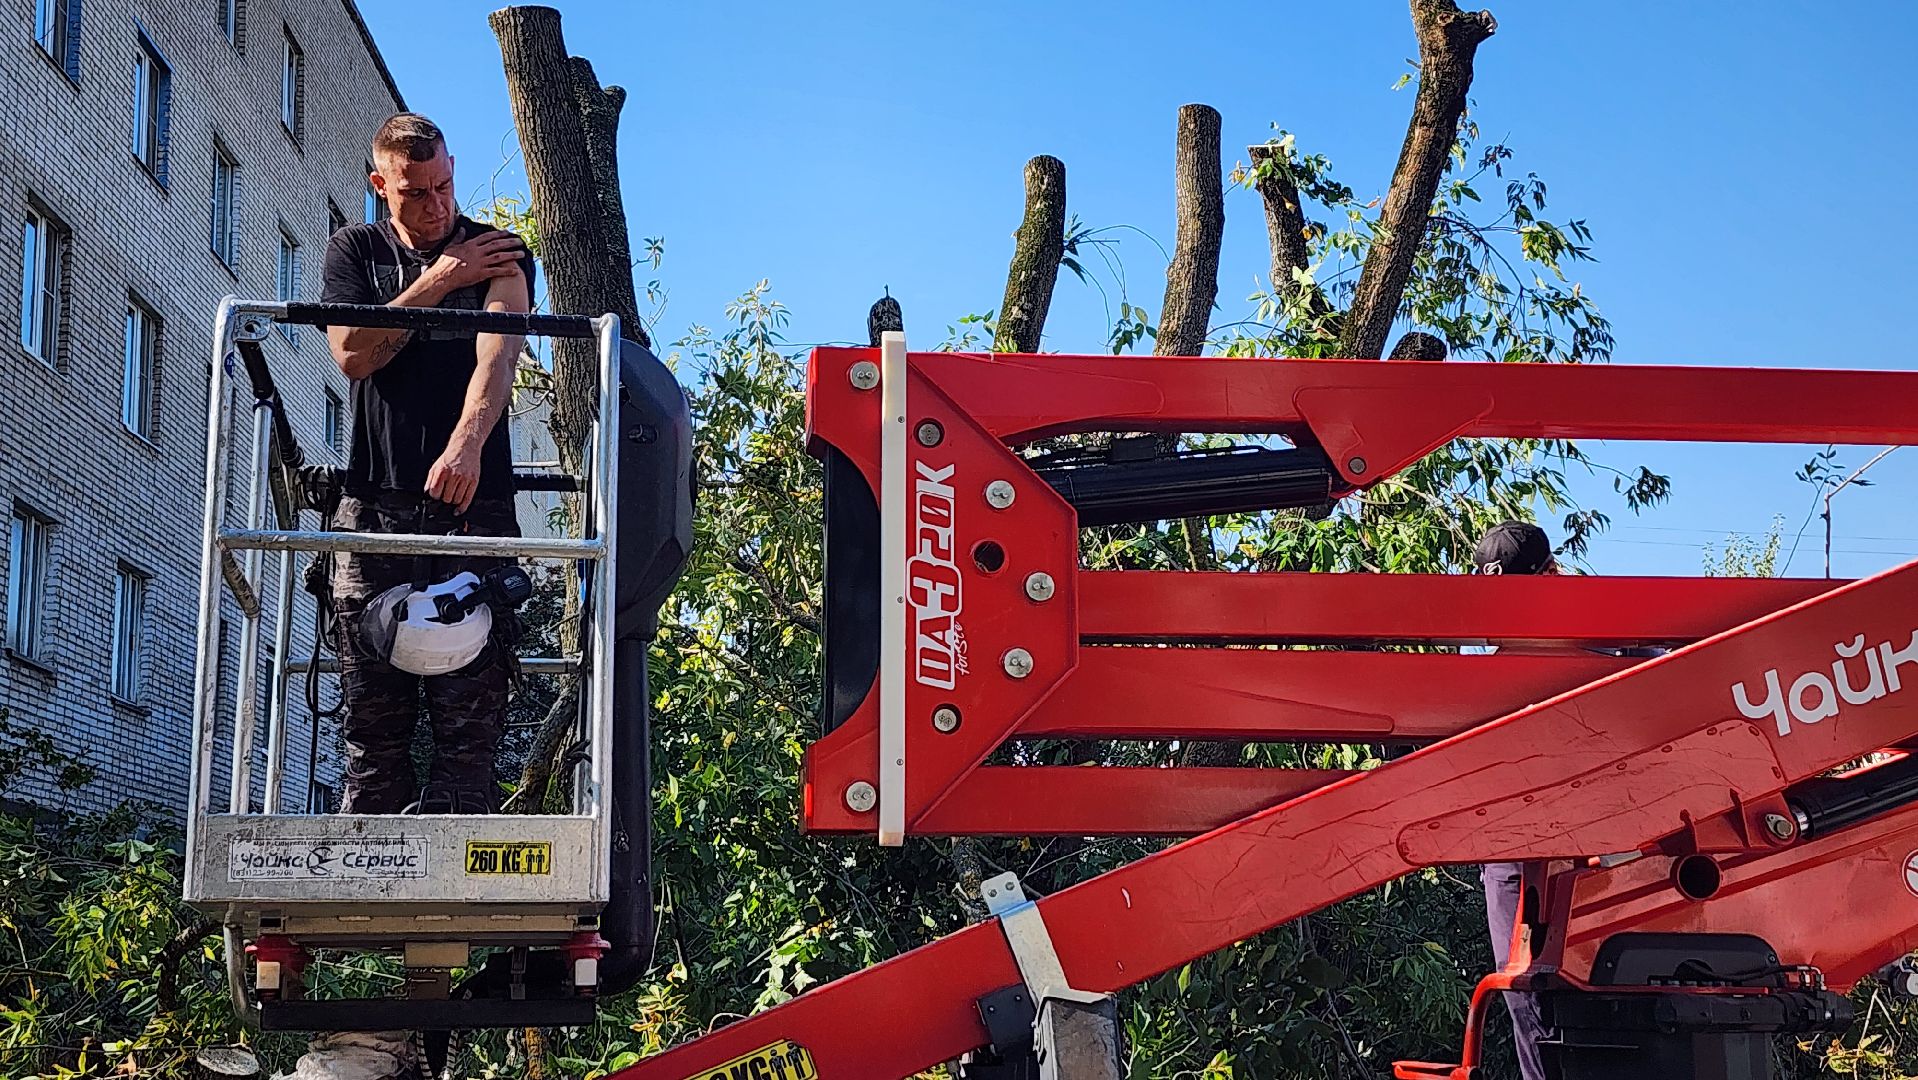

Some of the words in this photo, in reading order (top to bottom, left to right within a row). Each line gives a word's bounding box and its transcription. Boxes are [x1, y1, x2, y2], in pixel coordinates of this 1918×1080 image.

[906, 459, 963, 691] DA320K
[342, 852, 418, 870] Сервис
[470, 850, 498, 872] 260
[502, 849, 521, 873] KG
